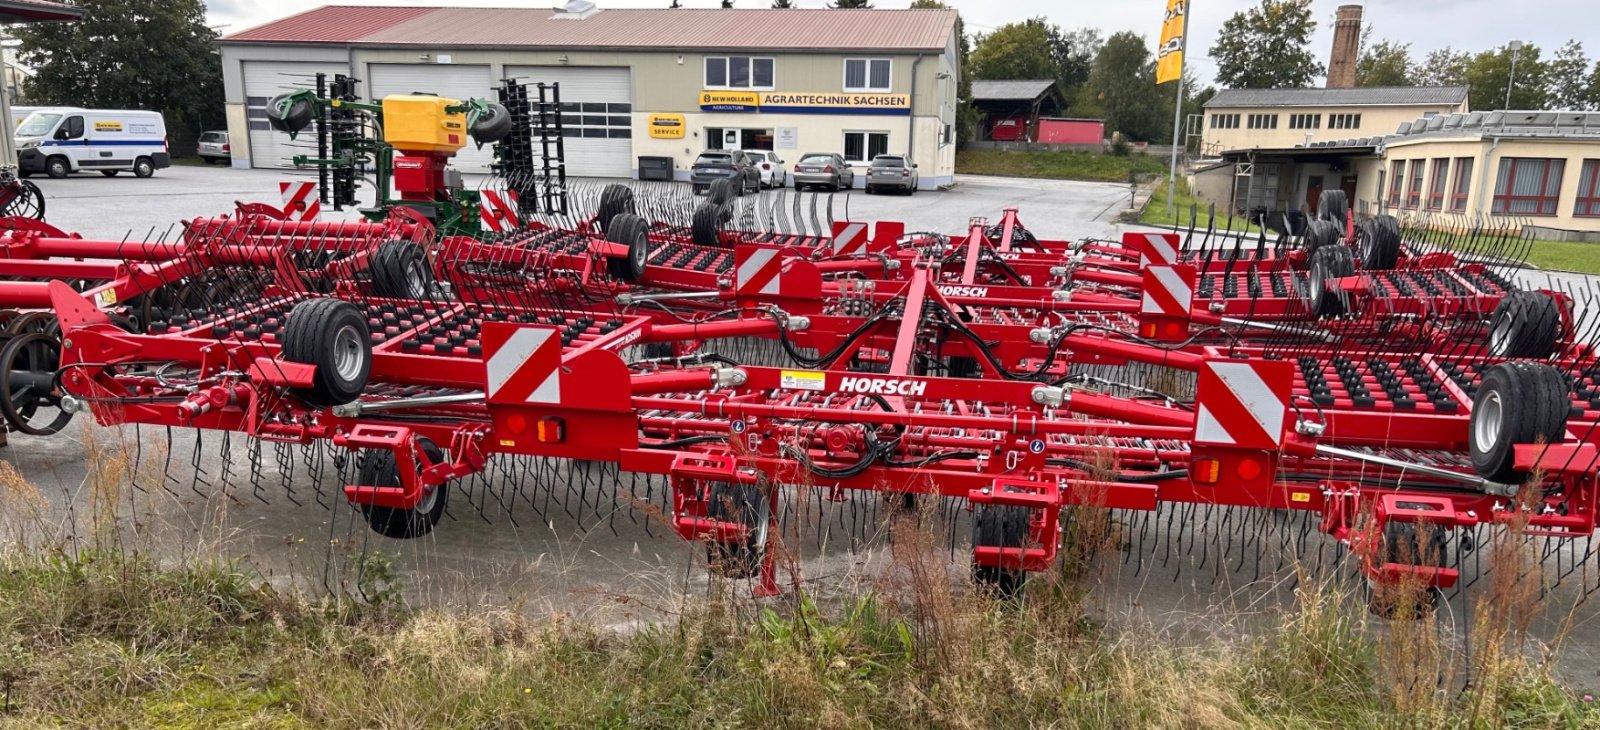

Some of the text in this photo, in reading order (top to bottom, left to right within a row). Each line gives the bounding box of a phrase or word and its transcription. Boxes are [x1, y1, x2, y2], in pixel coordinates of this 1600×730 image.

[764, 95, 905, 106] AGRARTECHNIK SACHSEN
[839, 377, 927, 396] HORSCH
